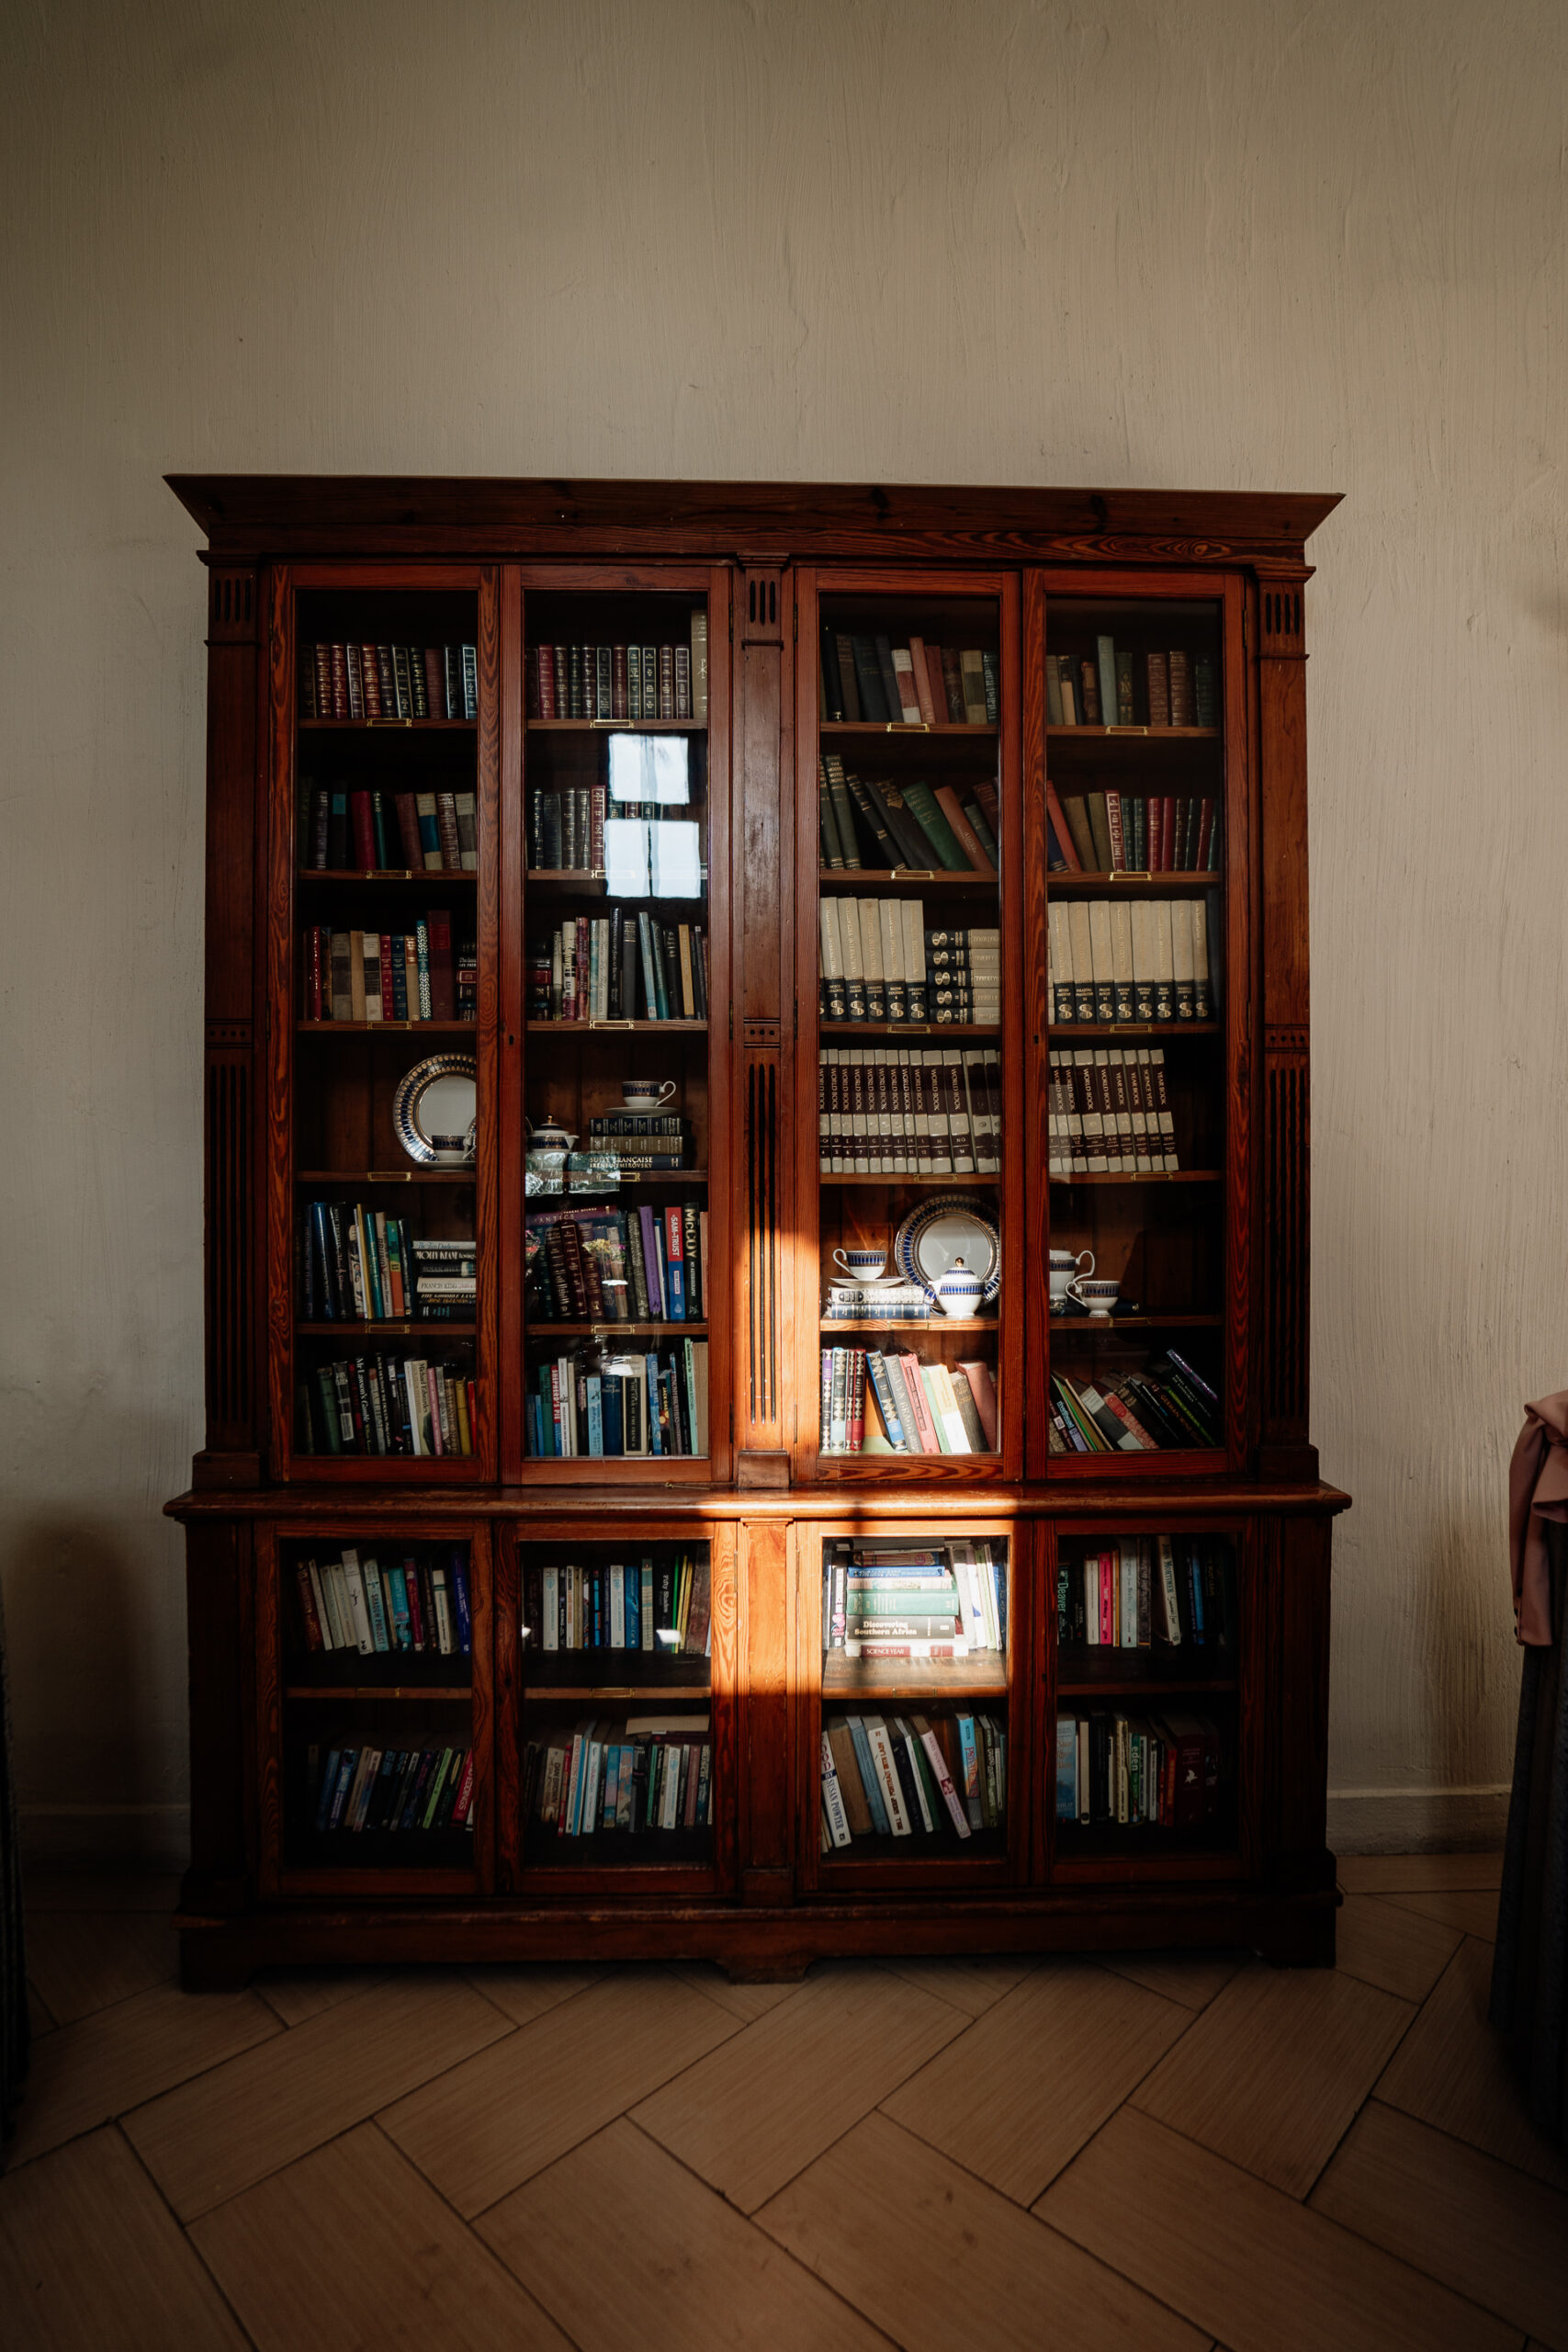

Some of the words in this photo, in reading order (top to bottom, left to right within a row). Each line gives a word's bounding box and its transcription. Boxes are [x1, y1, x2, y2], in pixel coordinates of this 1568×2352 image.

[841, 1069, 850, 1091] WORLD
[914, 1069, 922, 1091] WORLD
[951, 1069, 959, 1091] WORLD
[1082, 1069, 1091, 1091] WORLD
[1100, 1069, 1109, 1091] WORLD
[868, 1092, 876, 1110] BOOK
[879, 1092, 887, 1110] BOOK
[916, 1092, 924, 1110] BOOK
[1086, 1092, 1094, 1110] BOOK
[1103, 1092, 1111, 1110] BOOK
[684, 1208, 698, 1259] McCOY
[355, 1358, 364, 1369] Mr
[418, 1363, 427, 1385] Michael
[356, 1370, 367, 1399] Lawson's
[551, 1369, 560, 1406] SHEPHERD'S
[889, 1359, 908, 1398] MELVYN
[553, 1409, 561, 1420] PIE
[898, 1401, 913, 1434] BRAGG
[1056, 1581, 1069, 1613] Deaver
[863, 1621, 908, 1629] Discovering
[876, 1740, 886, 1757] LADY
[1131, 1746, 1139, 1771] eden
[551, 1778, 560, 1804] BROWN
[825, 1778, 839, 1802] SUSAN
[883, 1769, 896, 1797] PORTRAIT
[829, 1800, 844, 1831] POWTER
